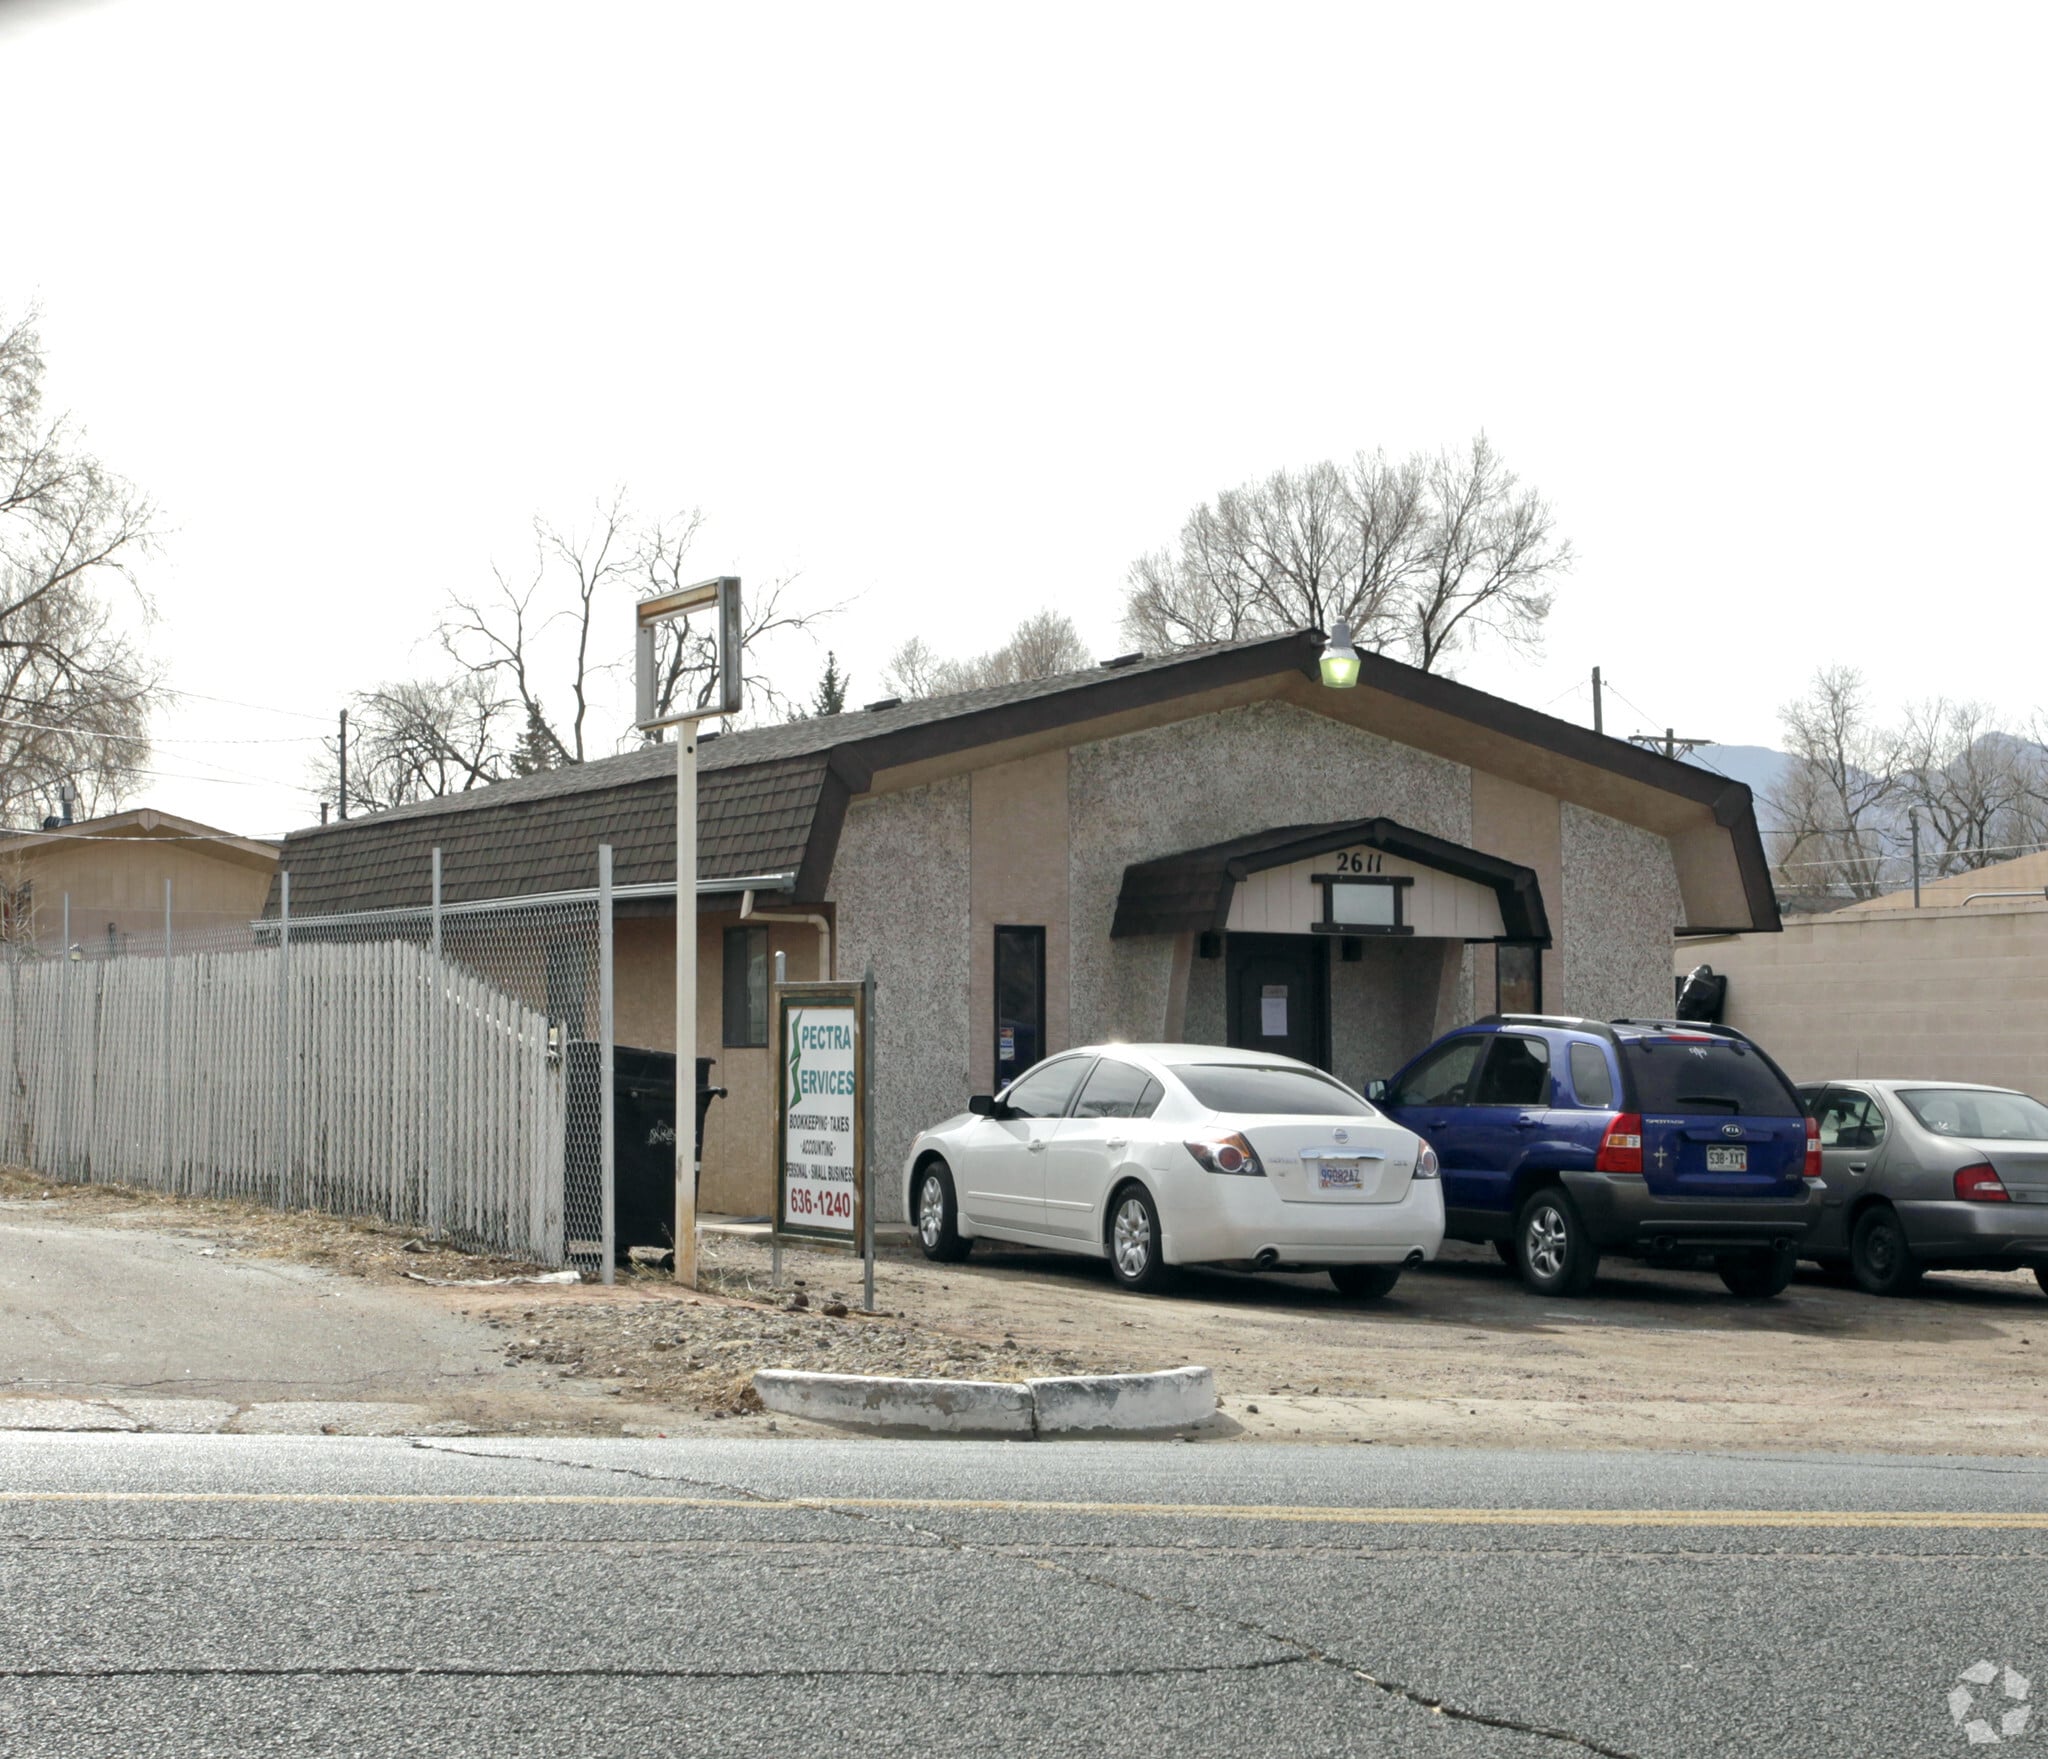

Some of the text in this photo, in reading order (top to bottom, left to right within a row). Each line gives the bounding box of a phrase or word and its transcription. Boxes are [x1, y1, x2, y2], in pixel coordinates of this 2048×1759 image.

[1337, 852, 1382, 873] 2611
[789, 1114, 849, 1132] BOOKKEEPING TAXES
[801, 1140, 833, 1157] ACCOUNTING
[811, 1164, 827, 1181] SMALL
[790, 1187, 851, 1218] 636-1240
